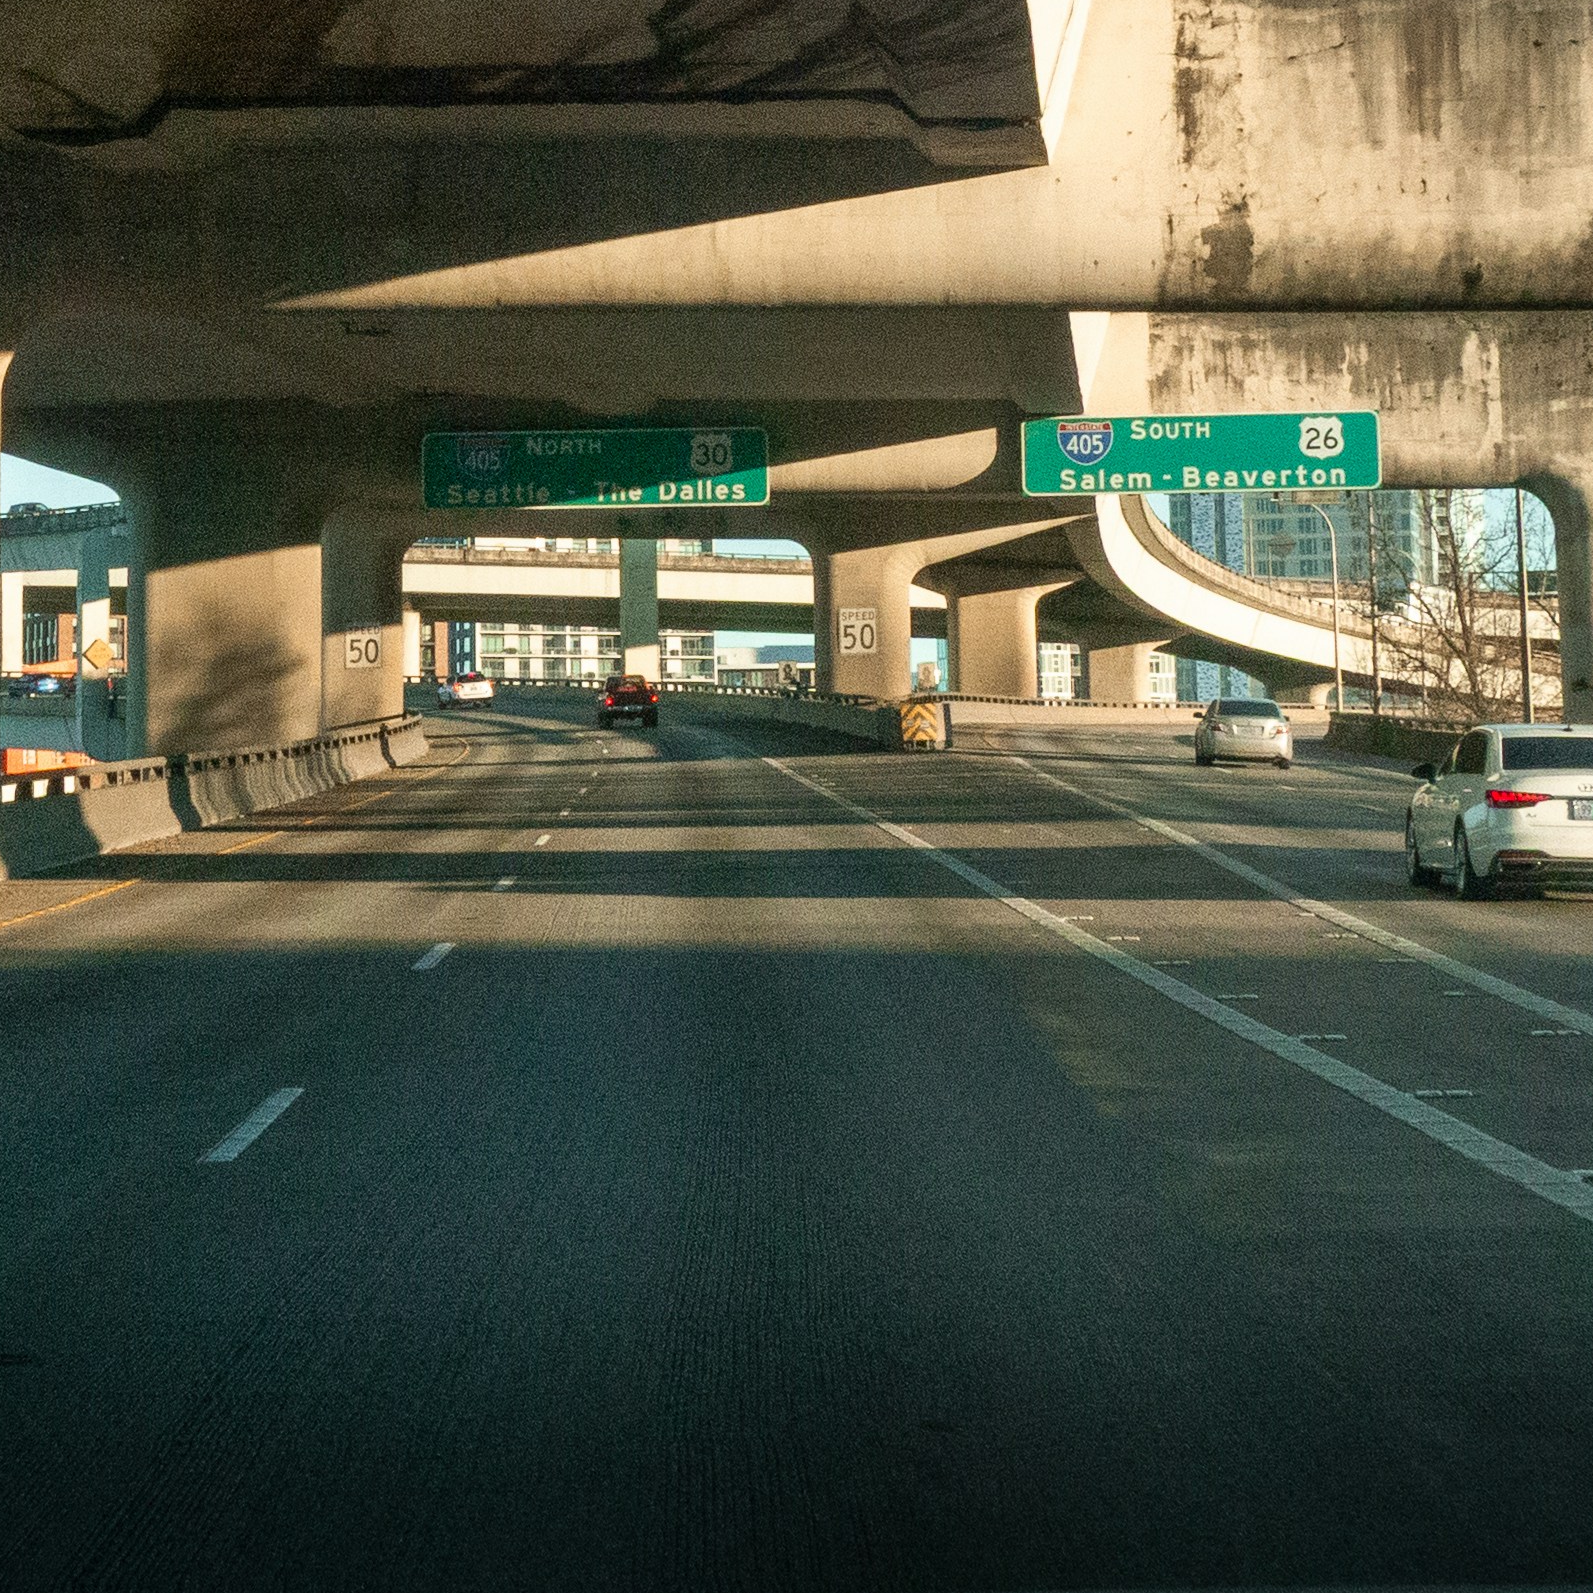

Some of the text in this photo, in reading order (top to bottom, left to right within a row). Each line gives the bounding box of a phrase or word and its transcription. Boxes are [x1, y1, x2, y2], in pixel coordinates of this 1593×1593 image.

[1130, 420, 1210, 440] SOUTH
[1306, 427, 1338, 450] 26
[526, 437, 602, 455] NORTH
[696, 442, 728, 466] 30
[1066, 434, 1104, 455] 405
[464, 450, 500, 470] 405
[1059, 469, 1152, 490] Salem
[1182, 465, 1346, 488] Beaverton
[448, 483, 550, 504] Seattle
[596, 480, 643, 502] The
[659, 480, 746, 501] Dalles
[841, 611, 875, 621] SPEED
[843, 624, 875, 650] 50
[349, 638, 379, 664] 50
